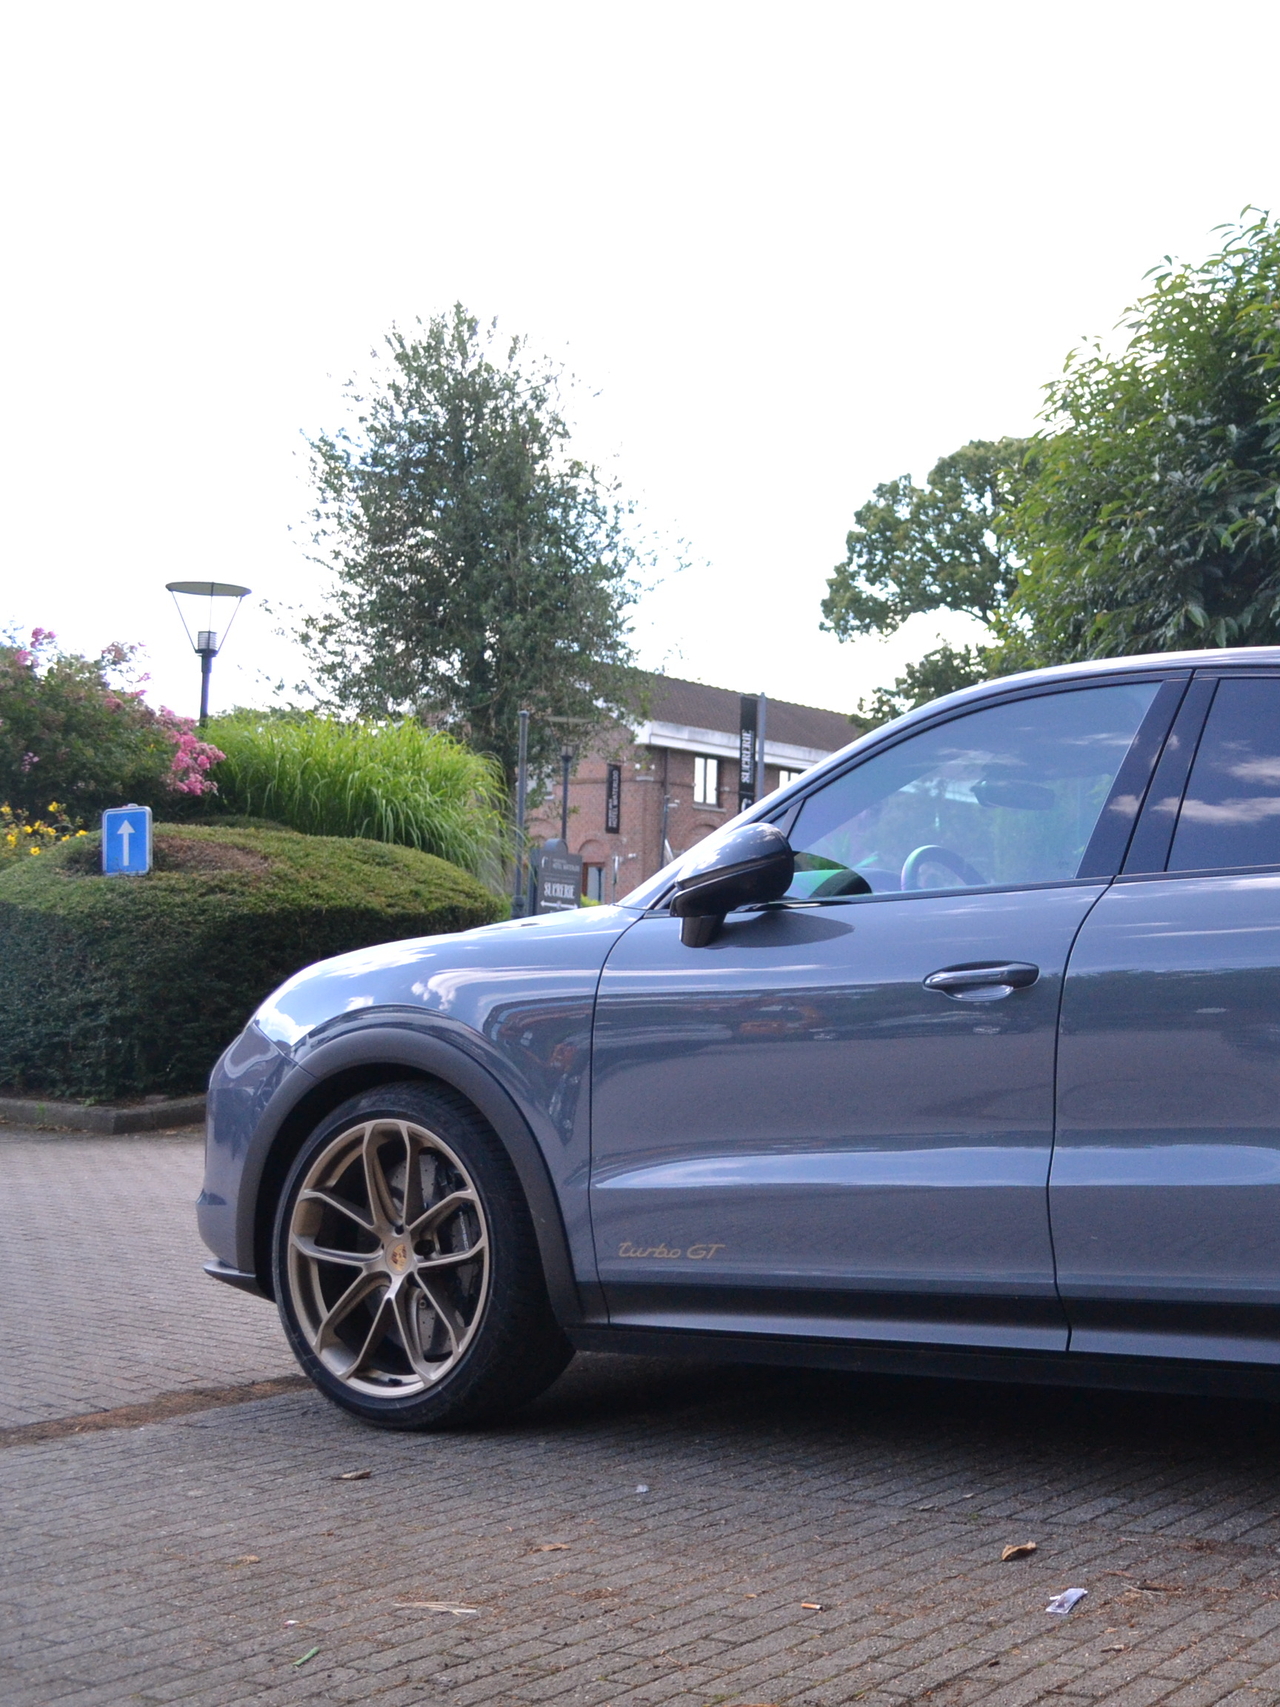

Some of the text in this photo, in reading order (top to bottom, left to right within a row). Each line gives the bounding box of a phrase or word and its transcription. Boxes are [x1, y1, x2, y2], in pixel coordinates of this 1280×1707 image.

[741, 729, 752, 784] SUCRERIE
[544, 881, 575, 899] SUCRERIE
[686, 1243, 726, 1260] GT
